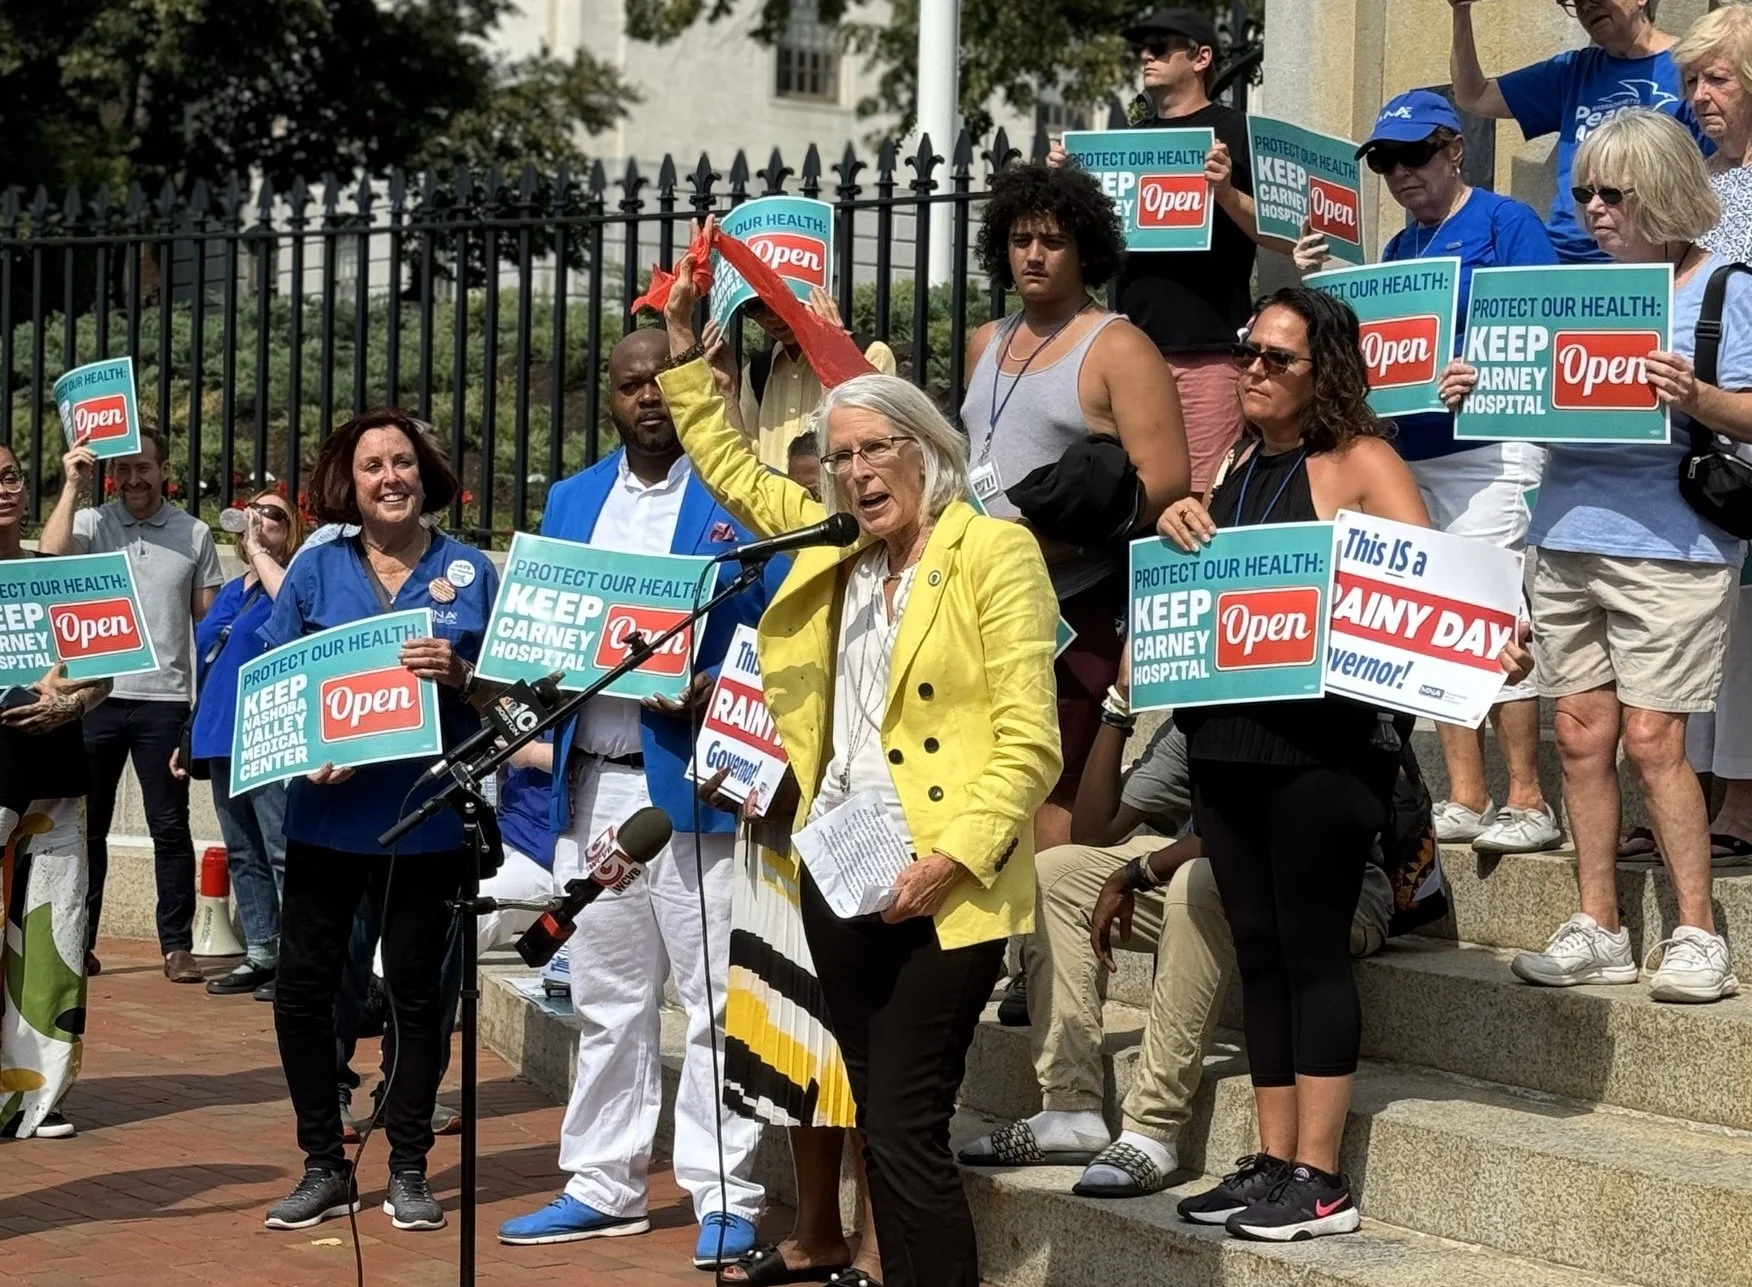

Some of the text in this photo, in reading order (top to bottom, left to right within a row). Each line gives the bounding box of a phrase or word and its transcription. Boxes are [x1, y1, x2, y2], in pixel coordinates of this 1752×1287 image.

[1129, 151, 1154, 166] OUR
[1157, 150, 1205, 166] HEALTH
[1254, 135, 1358, 181] PROTECT OUR HEALTH:
[1257, 155, 1307, 191] KEEP
[1088, 171, 1136, 198] EP
[1142, 183, 1204, 220] Open
[1259, 183, 1308, 214] CARNEY
[735, 213, 827, 236] OUR HEALTH:
[1260, 203, 1305, 227] HOSPIT
[1311, 186, 1356, 227] Open
[750, 239, 823, 272] Open
[1350, 279, 1379, 299] OUR
[1382, 272, 1449, 295] HEALTH:
[1472, 295, 1662, 318] PROTECT OUR HEALTH:
[1361, 331, 1432, 378] Open
[1466, 325, 1549, 362] KEEP
[69, 376, 84, 392] OUR
[84, 367, 127, 386] HEALTH:
[1476, 366, 1548, 391] ARNEY
[1558, 343, 1649, 397] Open
[75, 407, 125, 435] Open
[1463, 395, 1547, 415] HOSPITAL
[1343, 527, 1428, 577] This IS a
[30, 580, 61, 596] OUR
[64, 573, 128, 594] HEALTH:
[513, 559, 707, 600] PROTECT OUR HEALTH:
[1134, 552, 1324, 590] PROTECT OUR HEALTH:
[503, 582, 604, 626] KEEP
[1134, 589, 1212, 634] KEEP
[0, 631, 48, 652] RNEY
[55, 612, 134, 649] Open
[496, 616, 595, 652] CARNEY
[1134, 629, 1210, 662] CARNEY
[1221, 603, 1312, 656] Open
[1430, 610, 1513, 661] DAY
[0, 652, 56, 670] SPITAL
[243, 623, 423, 690] PROTECT OUR HEALTH:
[490, 640, 586, 672] HOSPITAL
[1134, 659, 1210, 686] HOSPITAL
[1327, 645, 1414, 690] vernor!
[243, 673, 308, 719] KEEP
[325, 685, 416, 728] Open
[242, 711, 308, 749] VALLEY
[243, 697, 308, 733] NASHOBA
[494, 704, 521, 737] BOSTON
[240, 745, 309, 782] CENTER
[241, 729, 308, 764] MEDICAL
[706, 740, 763, 788] Governor!
[612, 867, 642, 893] WCVB
